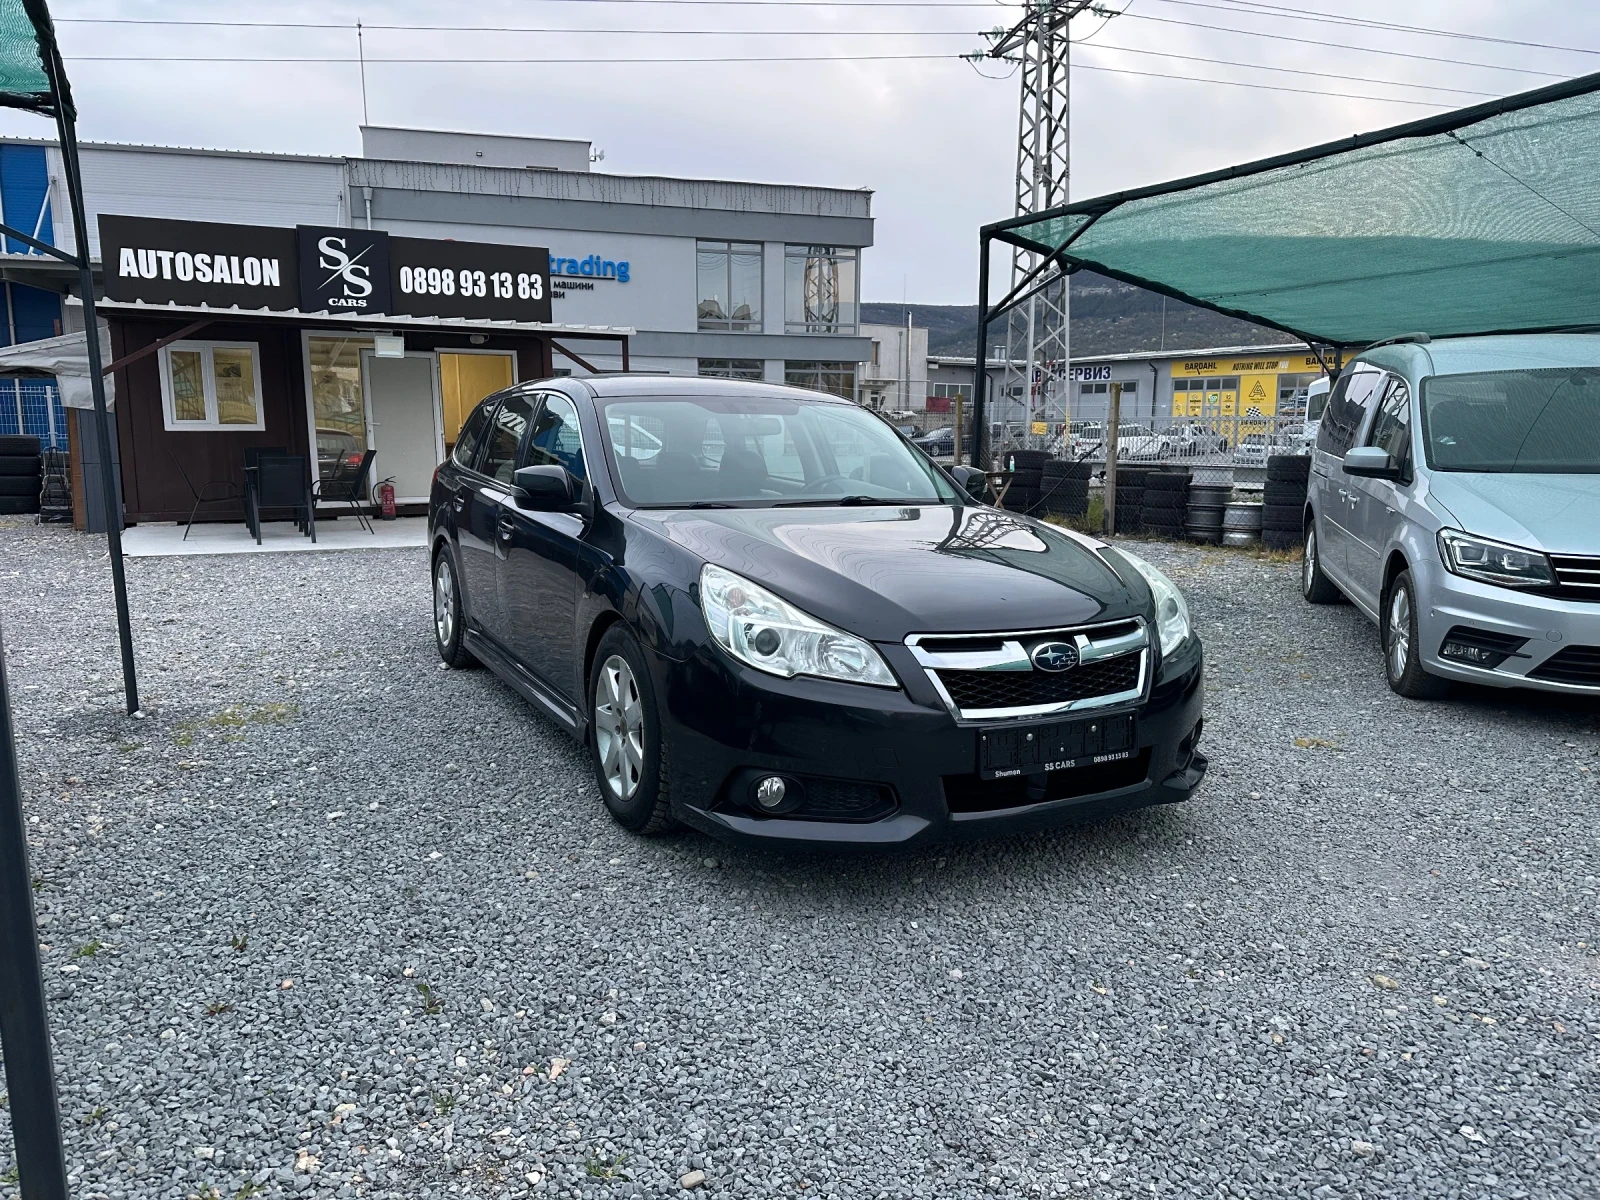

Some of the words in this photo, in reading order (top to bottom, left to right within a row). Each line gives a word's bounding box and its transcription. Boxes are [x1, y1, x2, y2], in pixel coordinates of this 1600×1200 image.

[118, 247, 281, 287] AUTOSALON
[549, 254, 630, 283] trading
[399, 266, 456, 296] 0898
[459, 269, 487, 298] 93
[490, 272, 514, 299] 13
[517, 273, 543, 300] 83
[553, 280, 594, 291] машини
[550, 290, 565, 299] ви
[328, 297, 368, 308] CARS
[1184, 361, 1217, 375] BARDAHL
[1232, 361, 1254, 371] NOTHING
[1254, 361, 1265, 370] WILL
[1265, 360, 1278, 370] STOP
[1055, 759, 1076, 769] CARS
